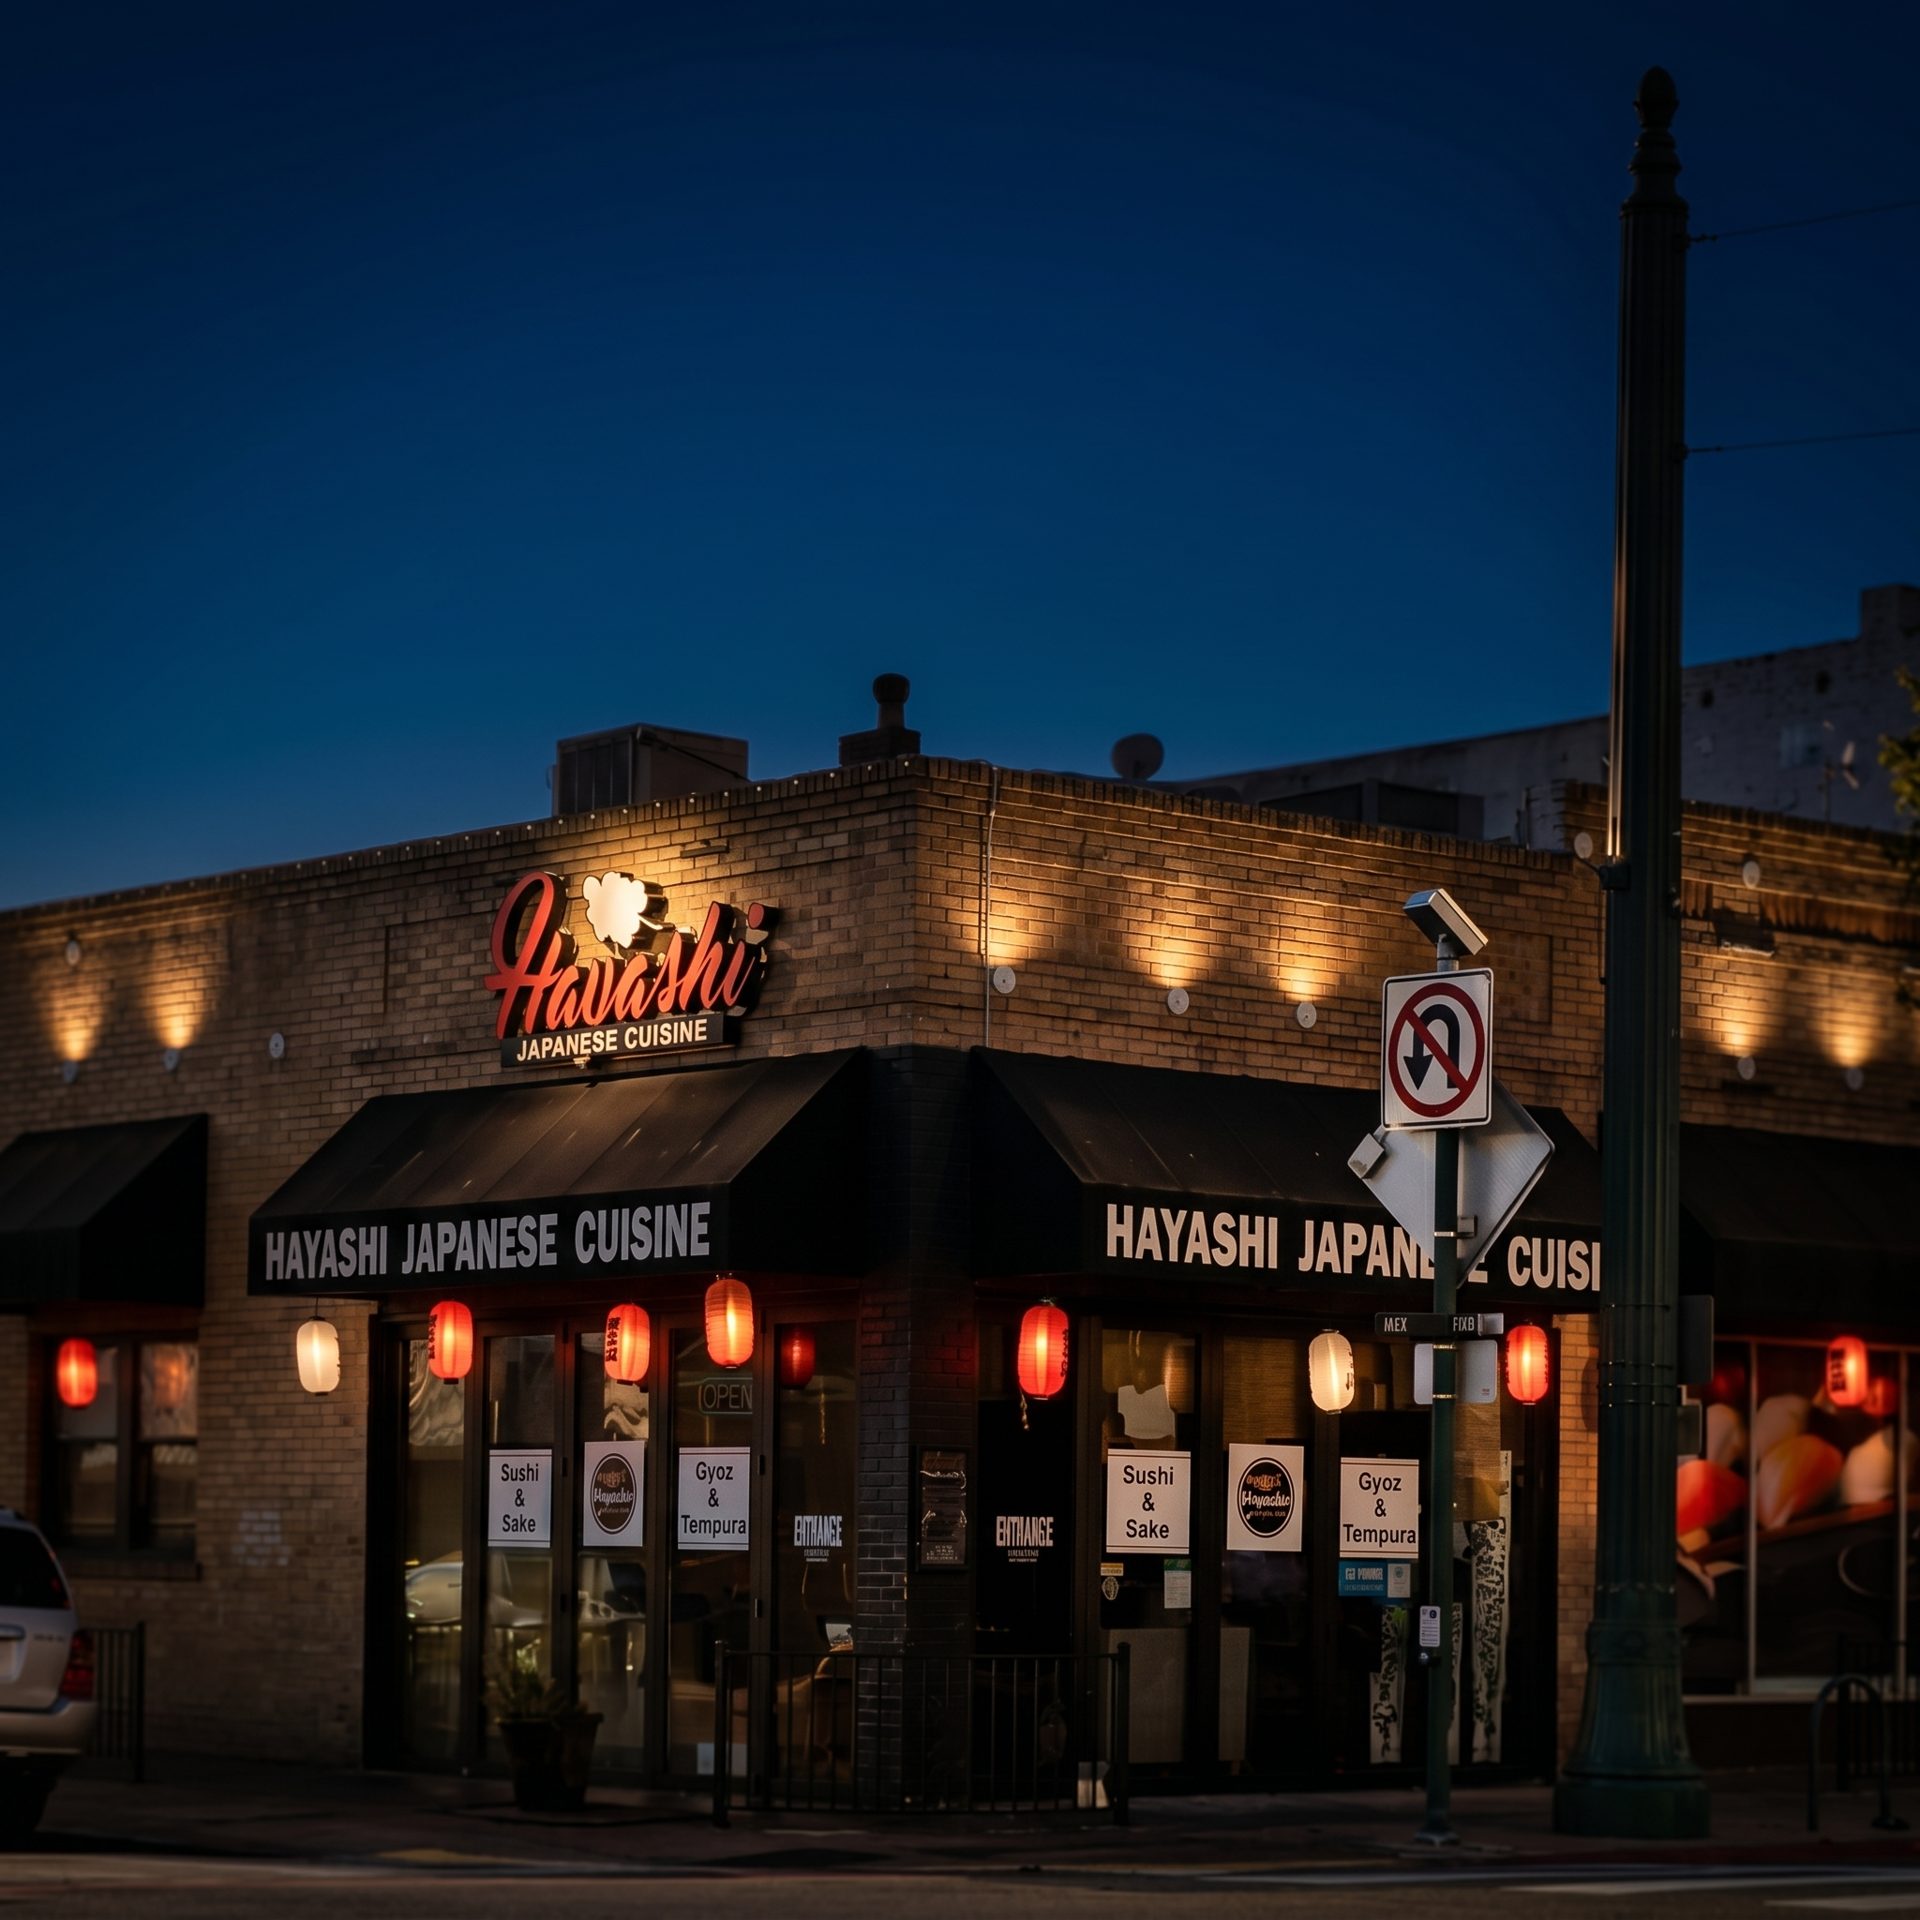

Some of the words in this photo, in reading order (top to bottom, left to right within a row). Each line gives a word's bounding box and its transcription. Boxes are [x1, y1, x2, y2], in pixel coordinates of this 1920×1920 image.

[517, 1029, 618, 1062] JAPANESE
[624, 1018, 708, 1050] CUISINE
[265, 1226, 388, 1282] HAYASHI
[401, 1213, 559, 1275] JAPANESE
[574, 1200, 711, 1265] CUISINE
[1106, 1202, 1279, 1270] HAYASHI
[1507, 1234, 1601, 1293] CUISI
[1383, 1316, 1408, 1332] MEX
[703, 1383, 753, 1409] OPEN
[501, 1463, 539, 1482] Sushi
[696, 1461, 734, 1483] Gyoz
[1123, 1464, 1174, 1486] Sushi
[1359, 1471, 1402, 1495] Gyoz
[514, 1488, 526, 1507] &
[708, 1487, 720, 1507] &
[1142, 1492, 1156, 1512] &
[1374, 1498, 1387, 1518] &
[502, 1513, 536, 1533] Sake
[681, 1514, 747, 1539] Tempura
[1126, 1519, 1170, 1540] Sake
[1343, 1523, 1417, 1548] Tempura
